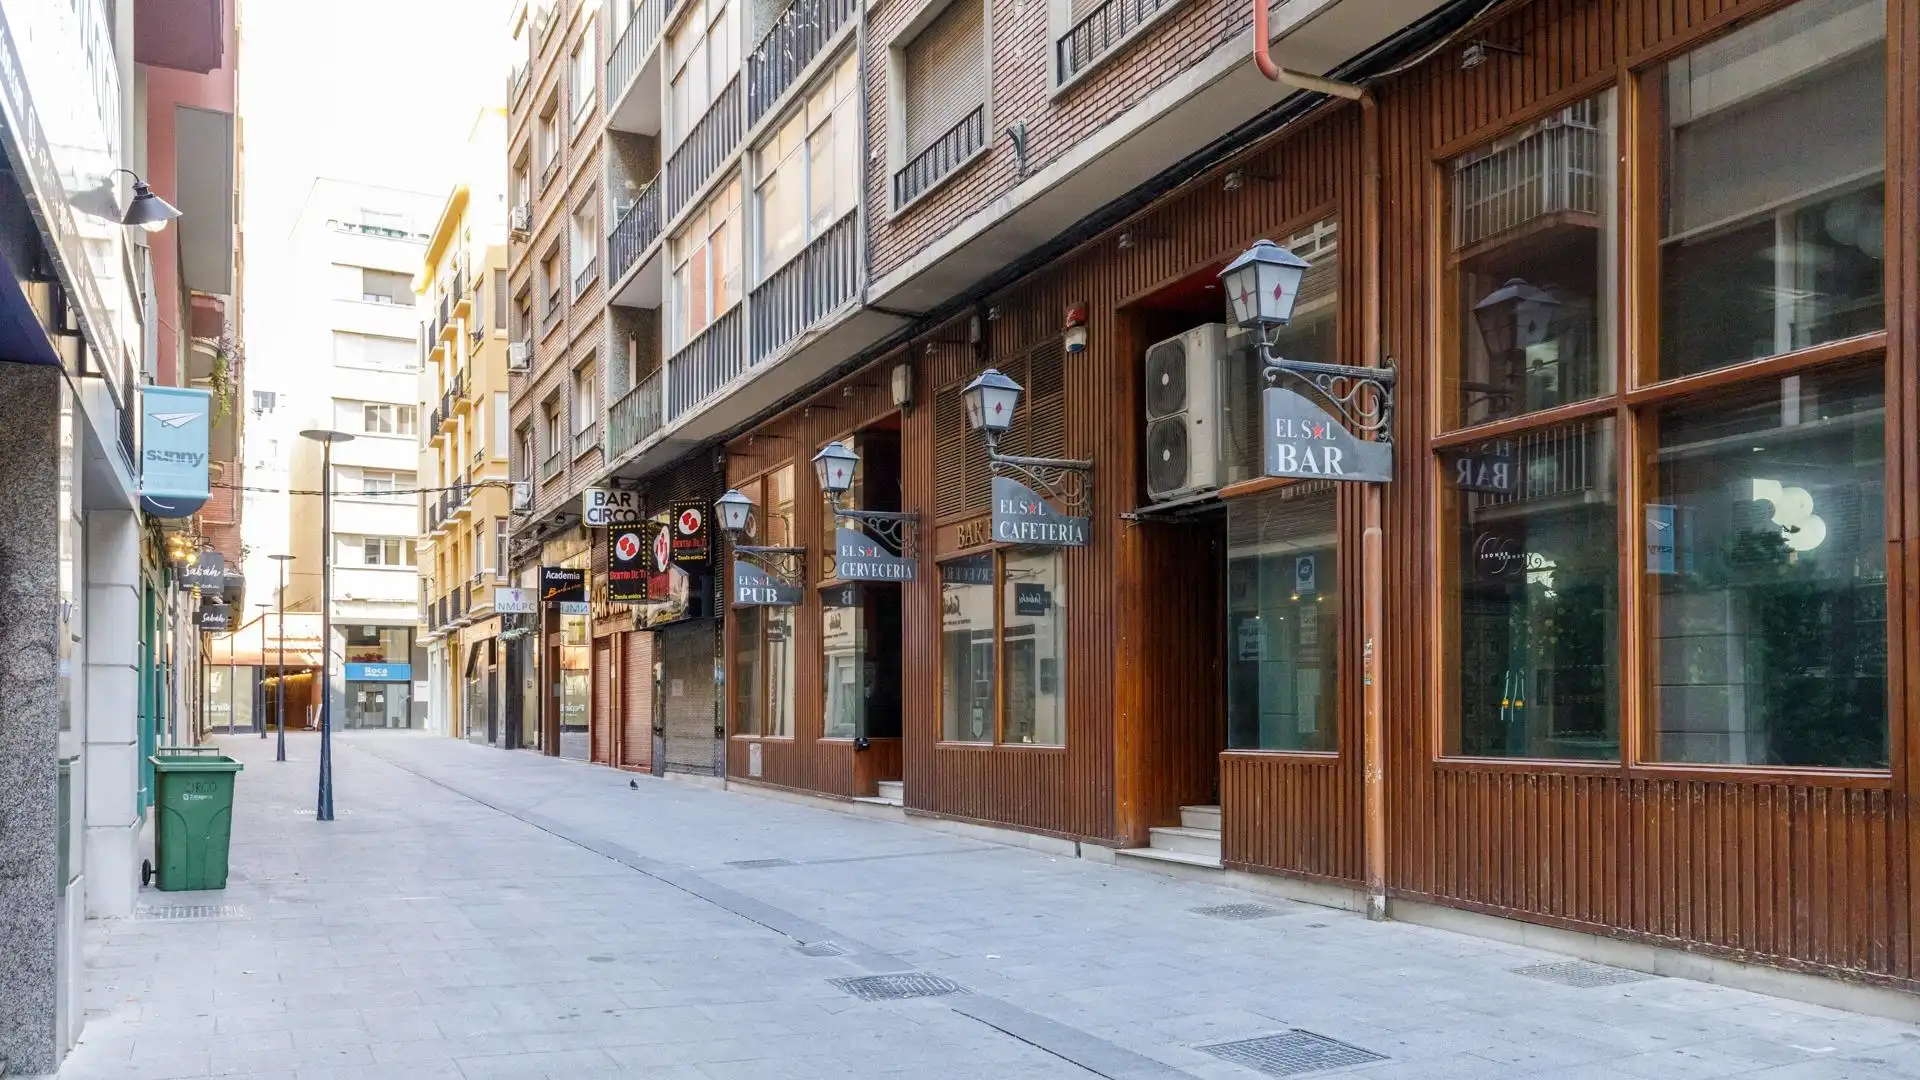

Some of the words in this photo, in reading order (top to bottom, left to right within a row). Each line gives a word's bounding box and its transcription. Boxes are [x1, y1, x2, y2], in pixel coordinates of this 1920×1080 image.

[1276, 418, 1297, 438] EL
[146, 449, 204, 468] sunny
[1276, 443, 1344, 475] BAR
[594, 491, 631, 507] BAR
[1000, 499, 1016, 514] EL
[587, 508, 637, 522] CIRCO
[956, 519, 985, 549] BAR
[999, 520, 1083, 542] CAFETERÍA
[842, 545, 856, 557] EL
[545, 570, 581, 580] Academia
[841, 560, 912, 578] CERVECERÍA
[738, 575, 751, 586] EL
[739, 587, 778, 603] PUB
[498, 602, 535, 613] NMLPC
